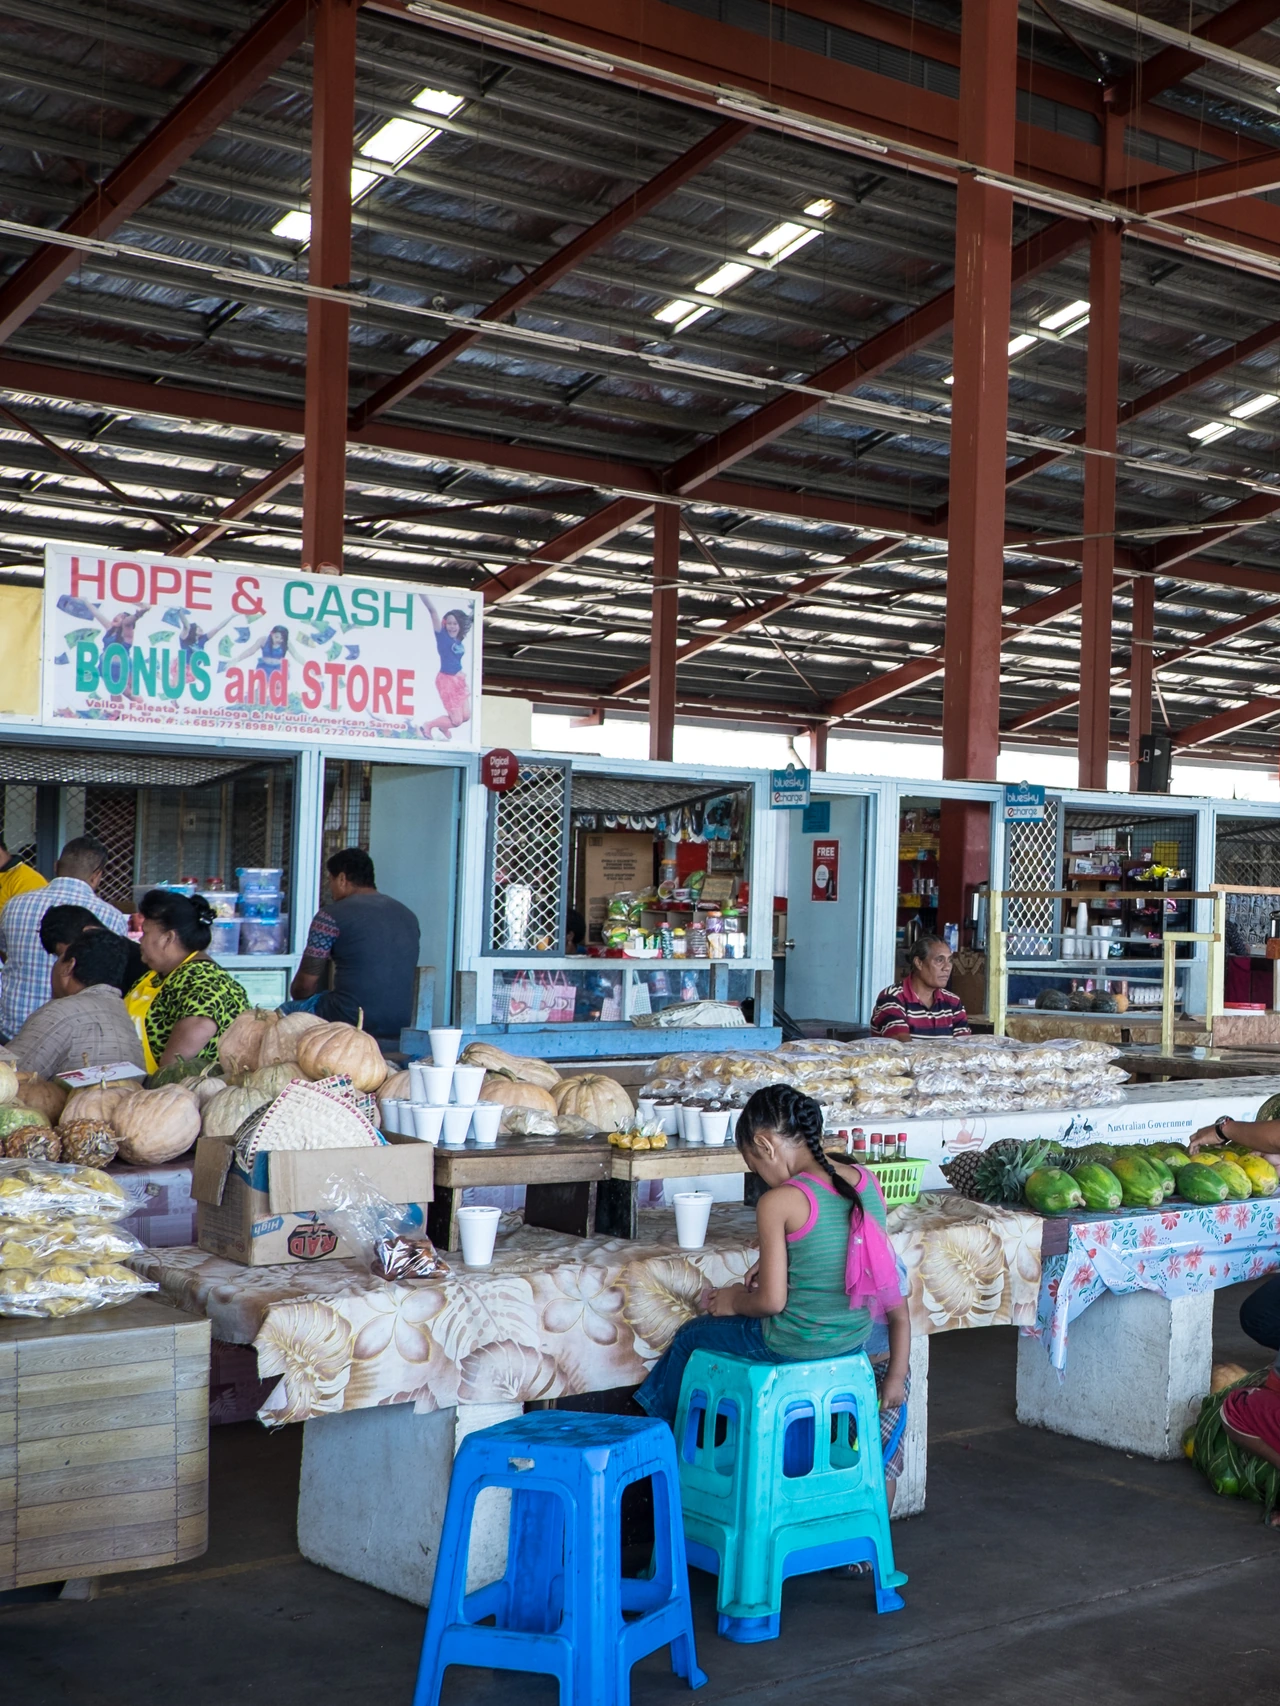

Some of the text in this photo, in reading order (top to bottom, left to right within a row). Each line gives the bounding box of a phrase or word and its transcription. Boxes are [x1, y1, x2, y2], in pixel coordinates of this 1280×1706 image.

[70, 556, 414, 630] HOPE & CASH
[75, 640, 415, 716] BONUS and STORE
[121, 713, 162, 725] Phone
[219, 720, 241, 729] 775
[245, 722, 274, 732] 8988
[285, 725, 321, 735] 01684
[324, 727, 345, 736] 272
[348, 729, 376, 738] 0704
[252, 711, 261, 719] &
[311, 715, 366, 727] American
[369, 720, 407, 730] Samoa
[490, 756, 510, 768] Digicel
[491, 768, 509, 777] TOP UP
[492, 776, 506, 785] HERE
[774, 777, 805, 790] bluesky
[1006, 792, 1040, 805] bluesky
[816, 846, 836, 857] FREE
[1108, 1120, 1192, 1132] Australian Government
[254, 1219, 279, 1235] High
[290, 1235, 336, 1255] RAD
